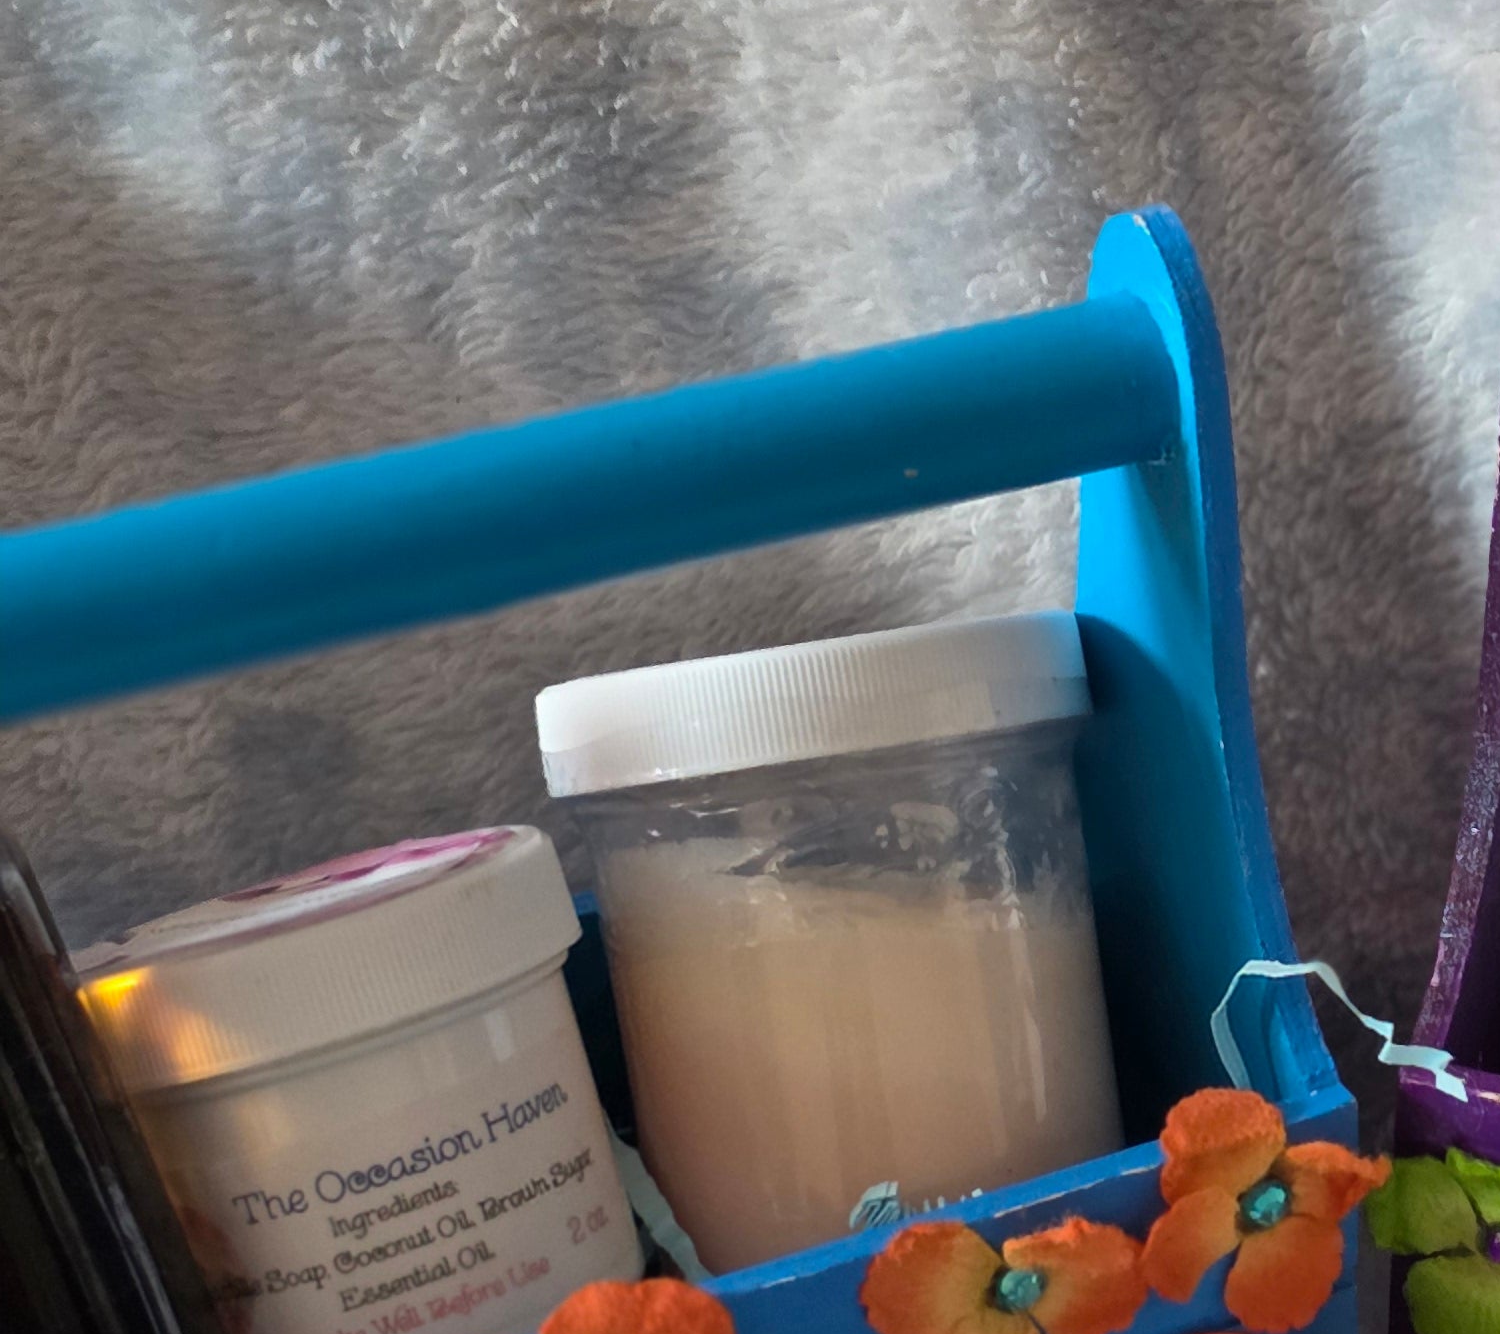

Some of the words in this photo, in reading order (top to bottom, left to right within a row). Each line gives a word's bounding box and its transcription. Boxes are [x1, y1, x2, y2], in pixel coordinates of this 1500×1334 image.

[232, 1188, 309, 1227] The
[315, 1137, 483, 1204] Occasion
[481, 1081, 570, 1144] Haven
[333, 1226, 438, 1274] Coconut
[478, 1177, 552, 1222] Brown
[338, 1257, 457, 1312] Essential
[428, 1274, 507, 1321] Before
